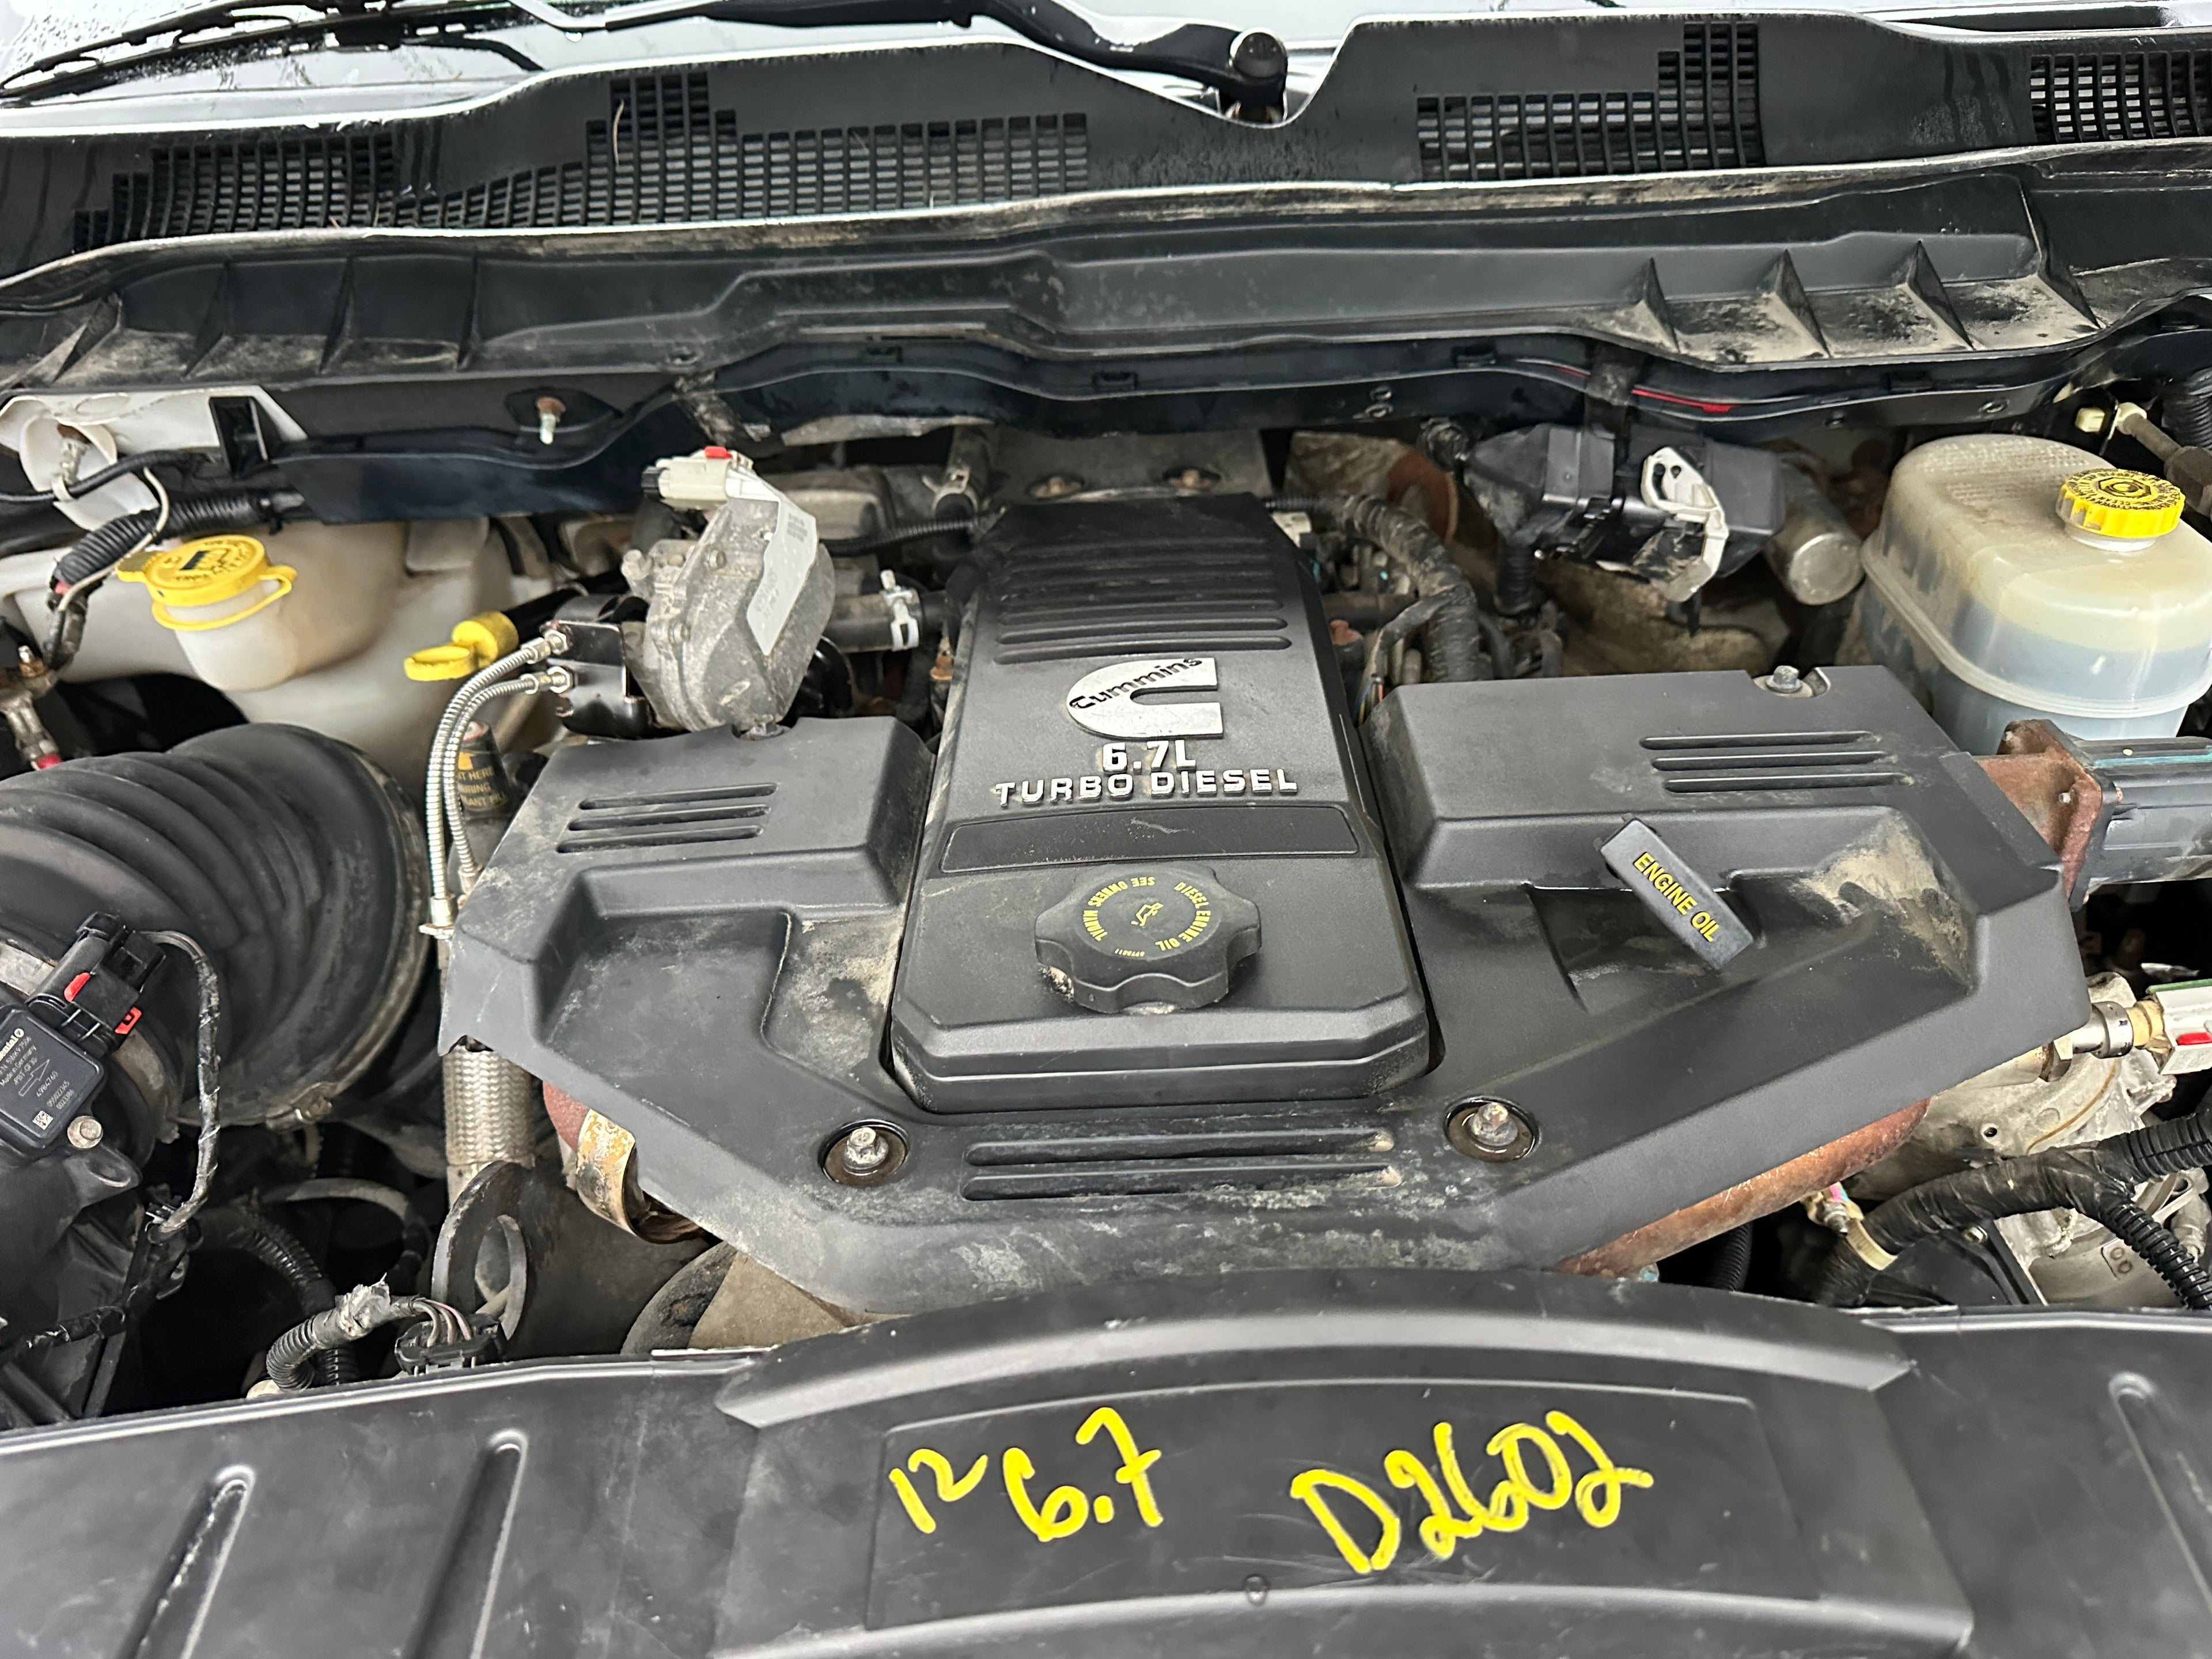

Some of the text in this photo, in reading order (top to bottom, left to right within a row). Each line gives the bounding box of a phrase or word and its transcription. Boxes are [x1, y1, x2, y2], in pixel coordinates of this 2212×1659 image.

[1069, 658, 1203, 709] Cummins
[1103, 740, 1196, 773] 6.7L
[995, 769, 1298, 806] TURBO DIESEL
[1131, 877, 1155, 887] SEE
[1633, 851, 1719, 942] ENGINE OIL
[1155, 881, 1211, 951] DIESEL ENGINE OIL
[889, 1407, 1654, 1574] 12 6.7 D2602
